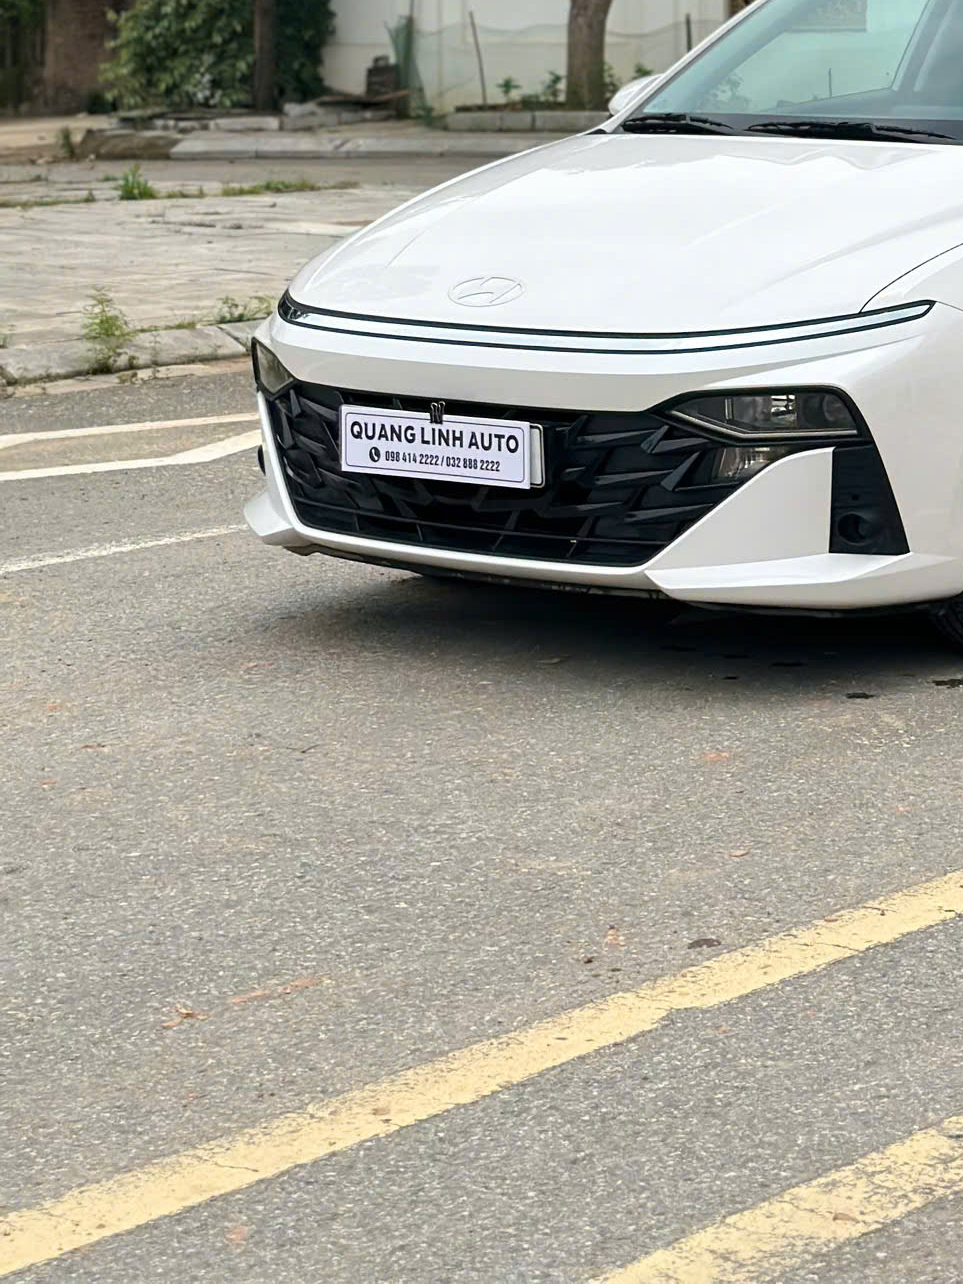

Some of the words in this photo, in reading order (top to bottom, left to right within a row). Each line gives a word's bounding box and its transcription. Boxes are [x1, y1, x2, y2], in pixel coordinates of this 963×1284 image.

[350, 421, 416, 444] QUANG
[420, 427, 464, 448] LINH
[468, 432, 519, 454] AUTO
[385, 450, 400, 462] 098
[402, 452, 417, 464] 414
[419, 453, 440, 466] 2222
[446, 456, 461, 468] 032
[463, 457, 478, 469] 888
[480, 459, 500, 472] 2222
